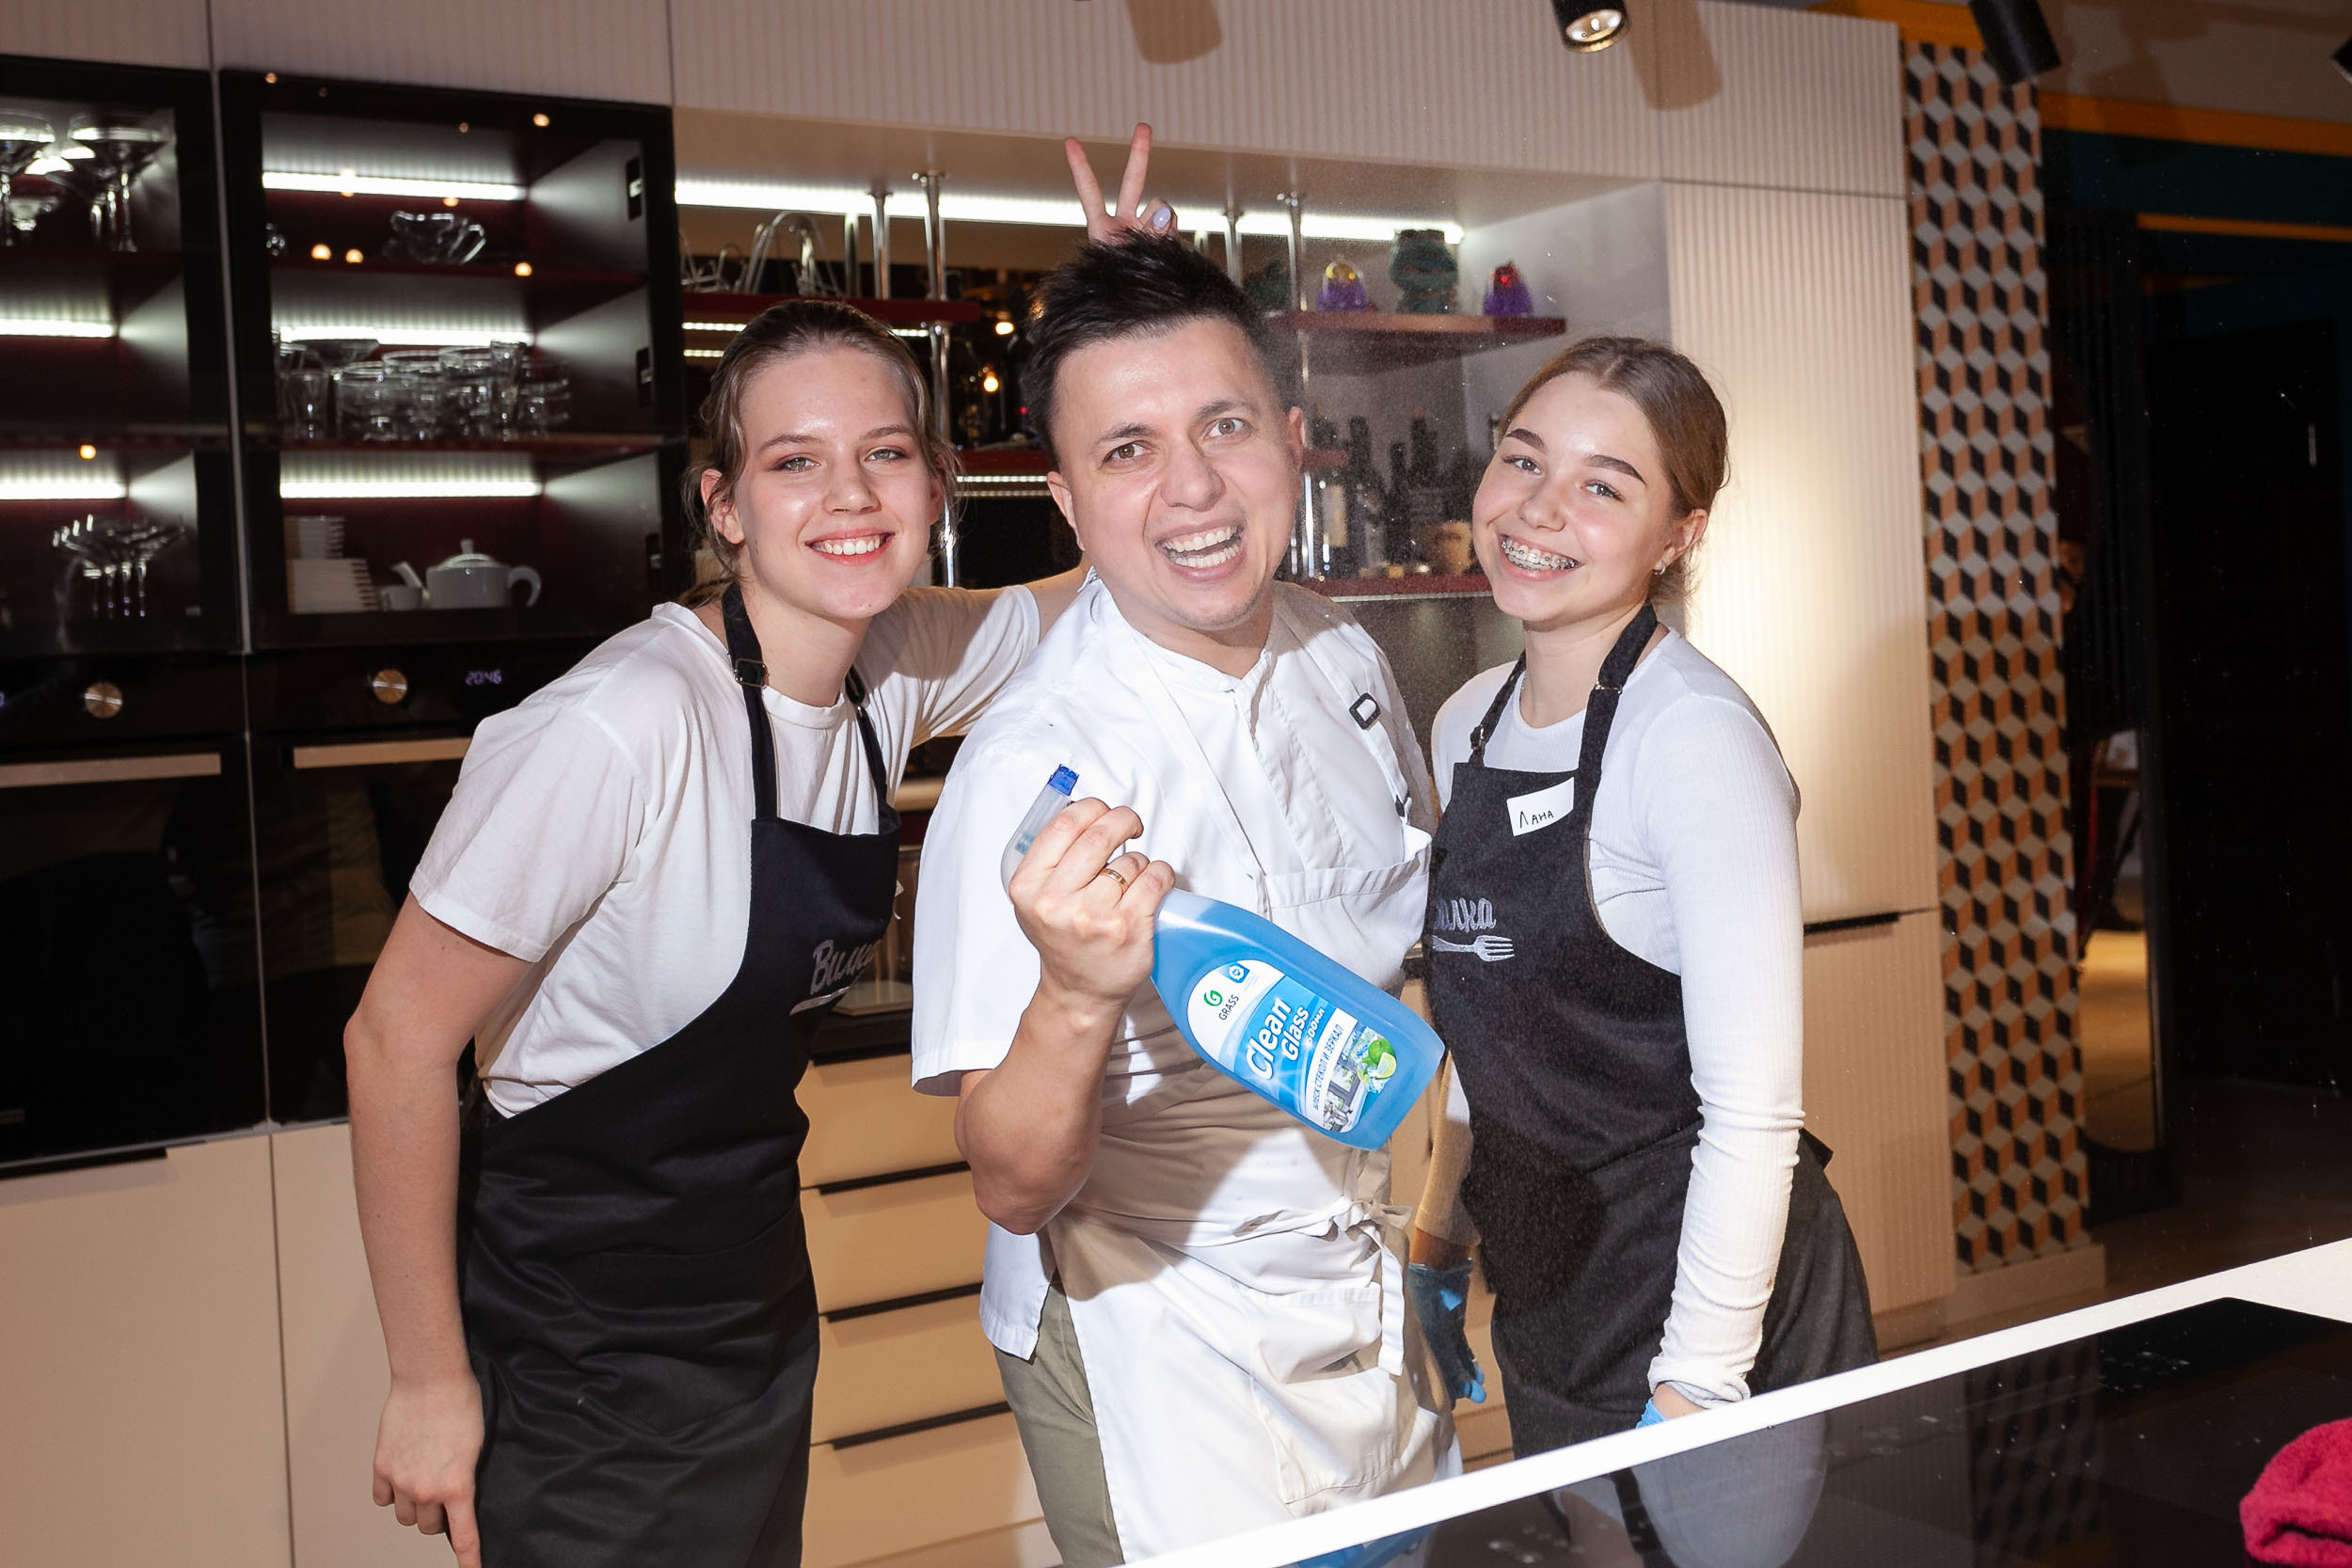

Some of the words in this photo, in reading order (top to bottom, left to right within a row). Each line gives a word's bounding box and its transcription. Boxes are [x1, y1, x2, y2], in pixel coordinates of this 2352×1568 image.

[1218, 994, 1239, 1021] GRASS
[1280, 1006, 1310, 1061] Glass
[1246, 998, 1292, 1080] Clean
[1314, 1058, 1327, 1087] СТЕКОЛ
[1325, 1023, 1343, 1053] ЗЕРКАЛ
